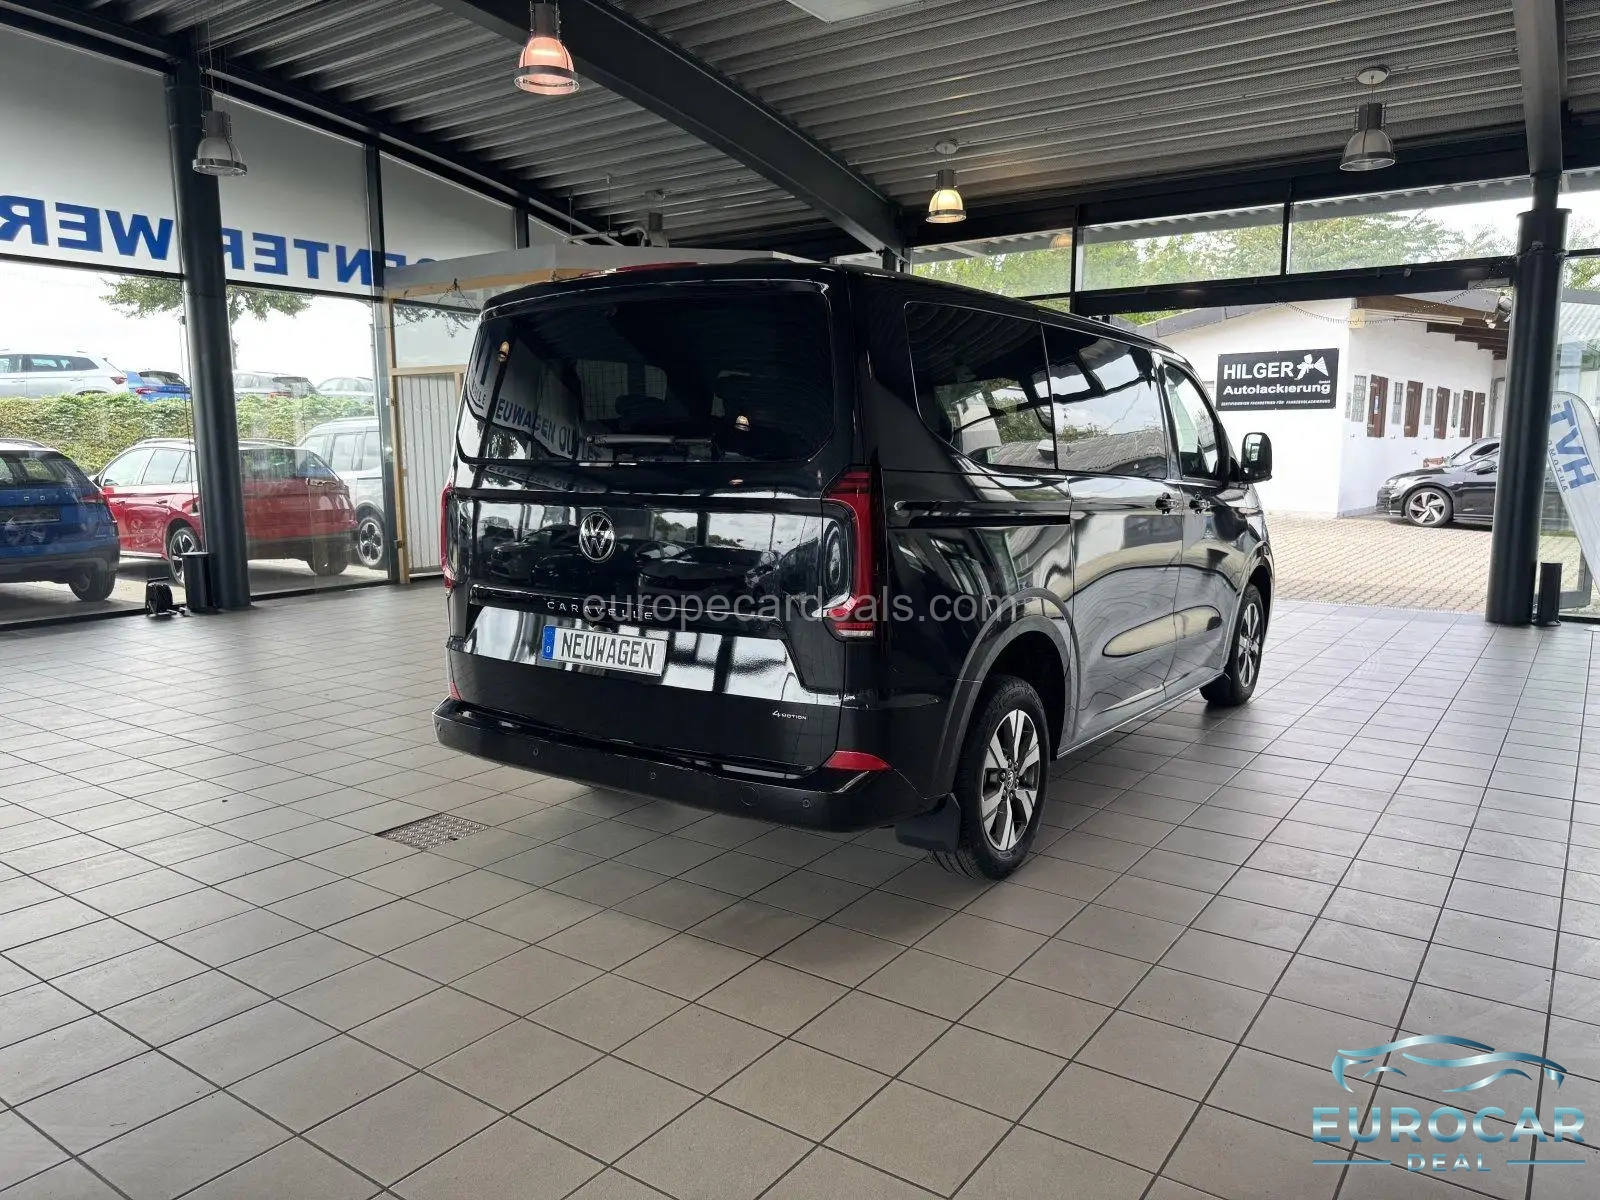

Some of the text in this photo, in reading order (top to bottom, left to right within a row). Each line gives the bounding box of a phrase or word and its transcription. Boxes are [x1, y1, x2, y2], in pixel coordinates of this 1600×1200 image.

[1223, 361, 1295, 380] HILGER
[1222, 383, 1331, 396] Autolackierung
[495, 398, 556, 444] EUWAGEN
[546, 600, 653, 620] CARAVELLE
[560, 632, 656, 670] NEUWAGEN
